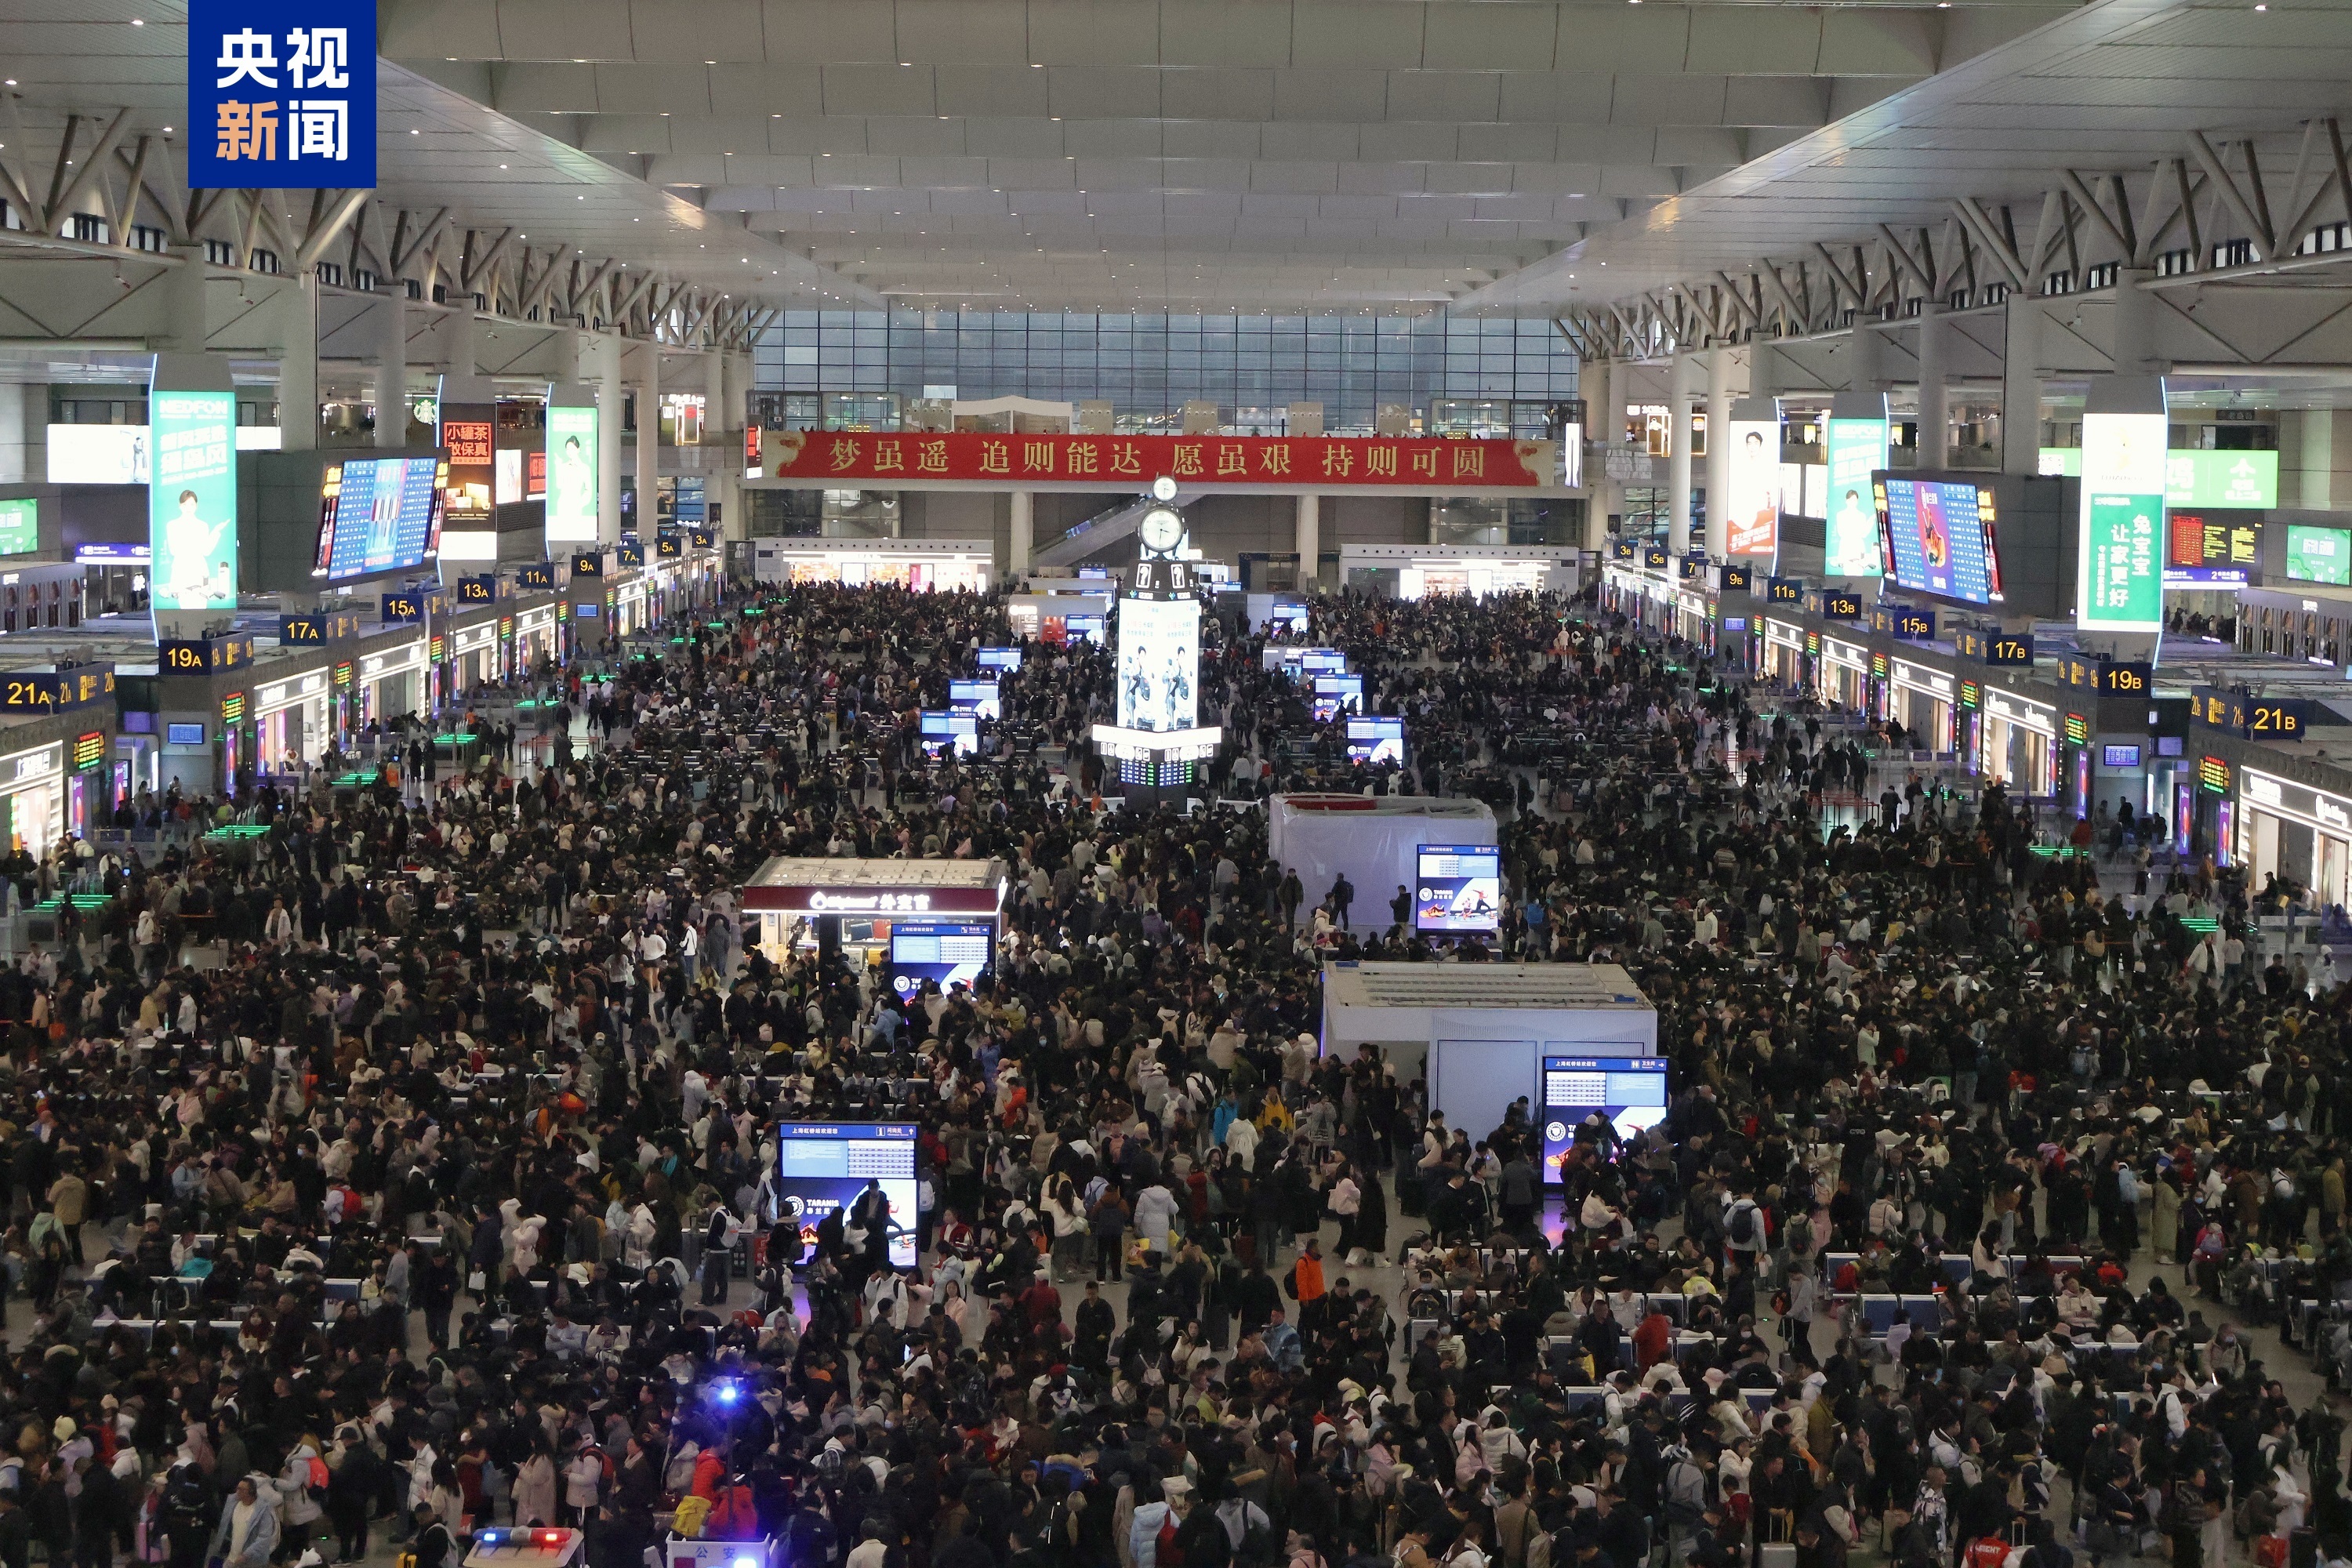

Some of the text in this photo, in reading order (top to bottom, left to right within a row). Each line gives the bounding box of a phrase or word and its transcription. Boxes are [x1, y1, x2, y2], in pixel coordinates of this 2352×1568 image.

[159, 399, 228, 415] NEDFON
[447, 425, 488, 441] 小罐茶
[448, 441, 488, 456] 敢保真
[828, 438, 1485, 478] 梦虽遥 追则能达 愿虽艰 持则可圆
[662, 542, 673, 553] 5A
[696, 535, 707, 545] 3A
[2131, 514, 2152, 576] 兔宝宝
[624, 550, 636, 561] 7A
[1621, 545, 1632, 555] 3B
[579, 559, 594, 572] 9A
[1652, 553, 1664, 564] 5B
[2108, 523, 2131, 608] 让家更好
[1689, 562, 1696, 573] 7
[527, 572, 547, 583] 11A
[1729, 573, 1743, 585] 9B
[464, 583, 488, 598] 13A
[1775, 586, 1795, 598] 11B
[390, 600, 416, 615] 15A
[1831, 599, 1855, 614] 13B
[288, 622, 318, 638] 17A
[1902, 618, 1928, 633] 15B
[168, 648, 202, 667] 19A
[1995, 641, 2026, 659] 17B
[2089, 669, 2099, 688] 19B
[2108, 670, 2142, 689] 19B
[7, 682, 51, 705] 21A
[60, 681, 72, 704] 21A
[2232, 705, 2245, 728] 21B
[2253, 708, 2296, 730] 21B
[695, 1545, 736, 1560] 公安
